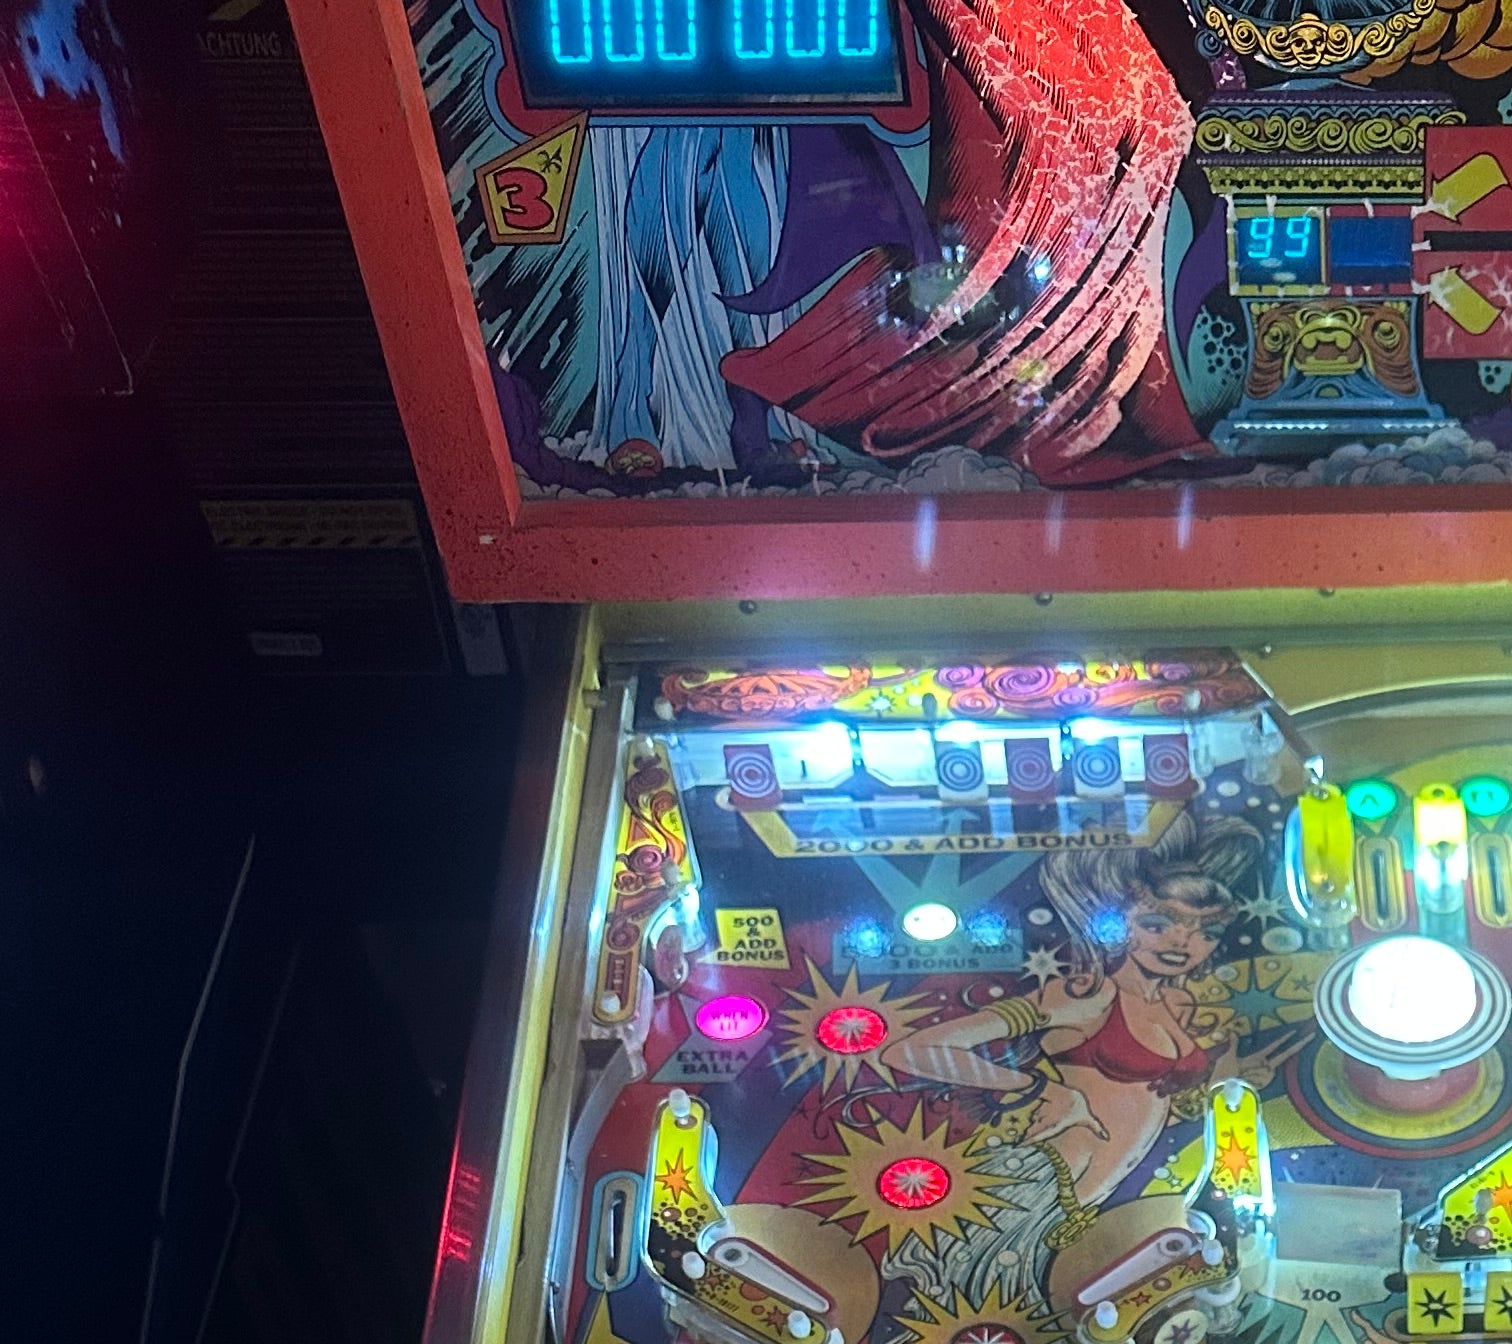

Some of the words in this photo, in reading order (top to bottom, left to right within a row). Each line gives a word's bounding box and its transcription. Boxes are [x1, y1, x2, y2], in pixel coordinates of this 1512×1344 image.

[493, 168, 553, 231] 3
[1247, 215, 1311, 259] 99
[795, 834, 895, 854] 2000
[904, 837, 924, 851] &
[931, 833, 1004, 852] ADD
[1015, 831, 1134, 850] BONUS
[733, 916, 774, 928] 500
[747, 927, 761, 938] &
[735, 938, 776, 951] ADD
[717, 949, 785, 962] BONUS
[677, 1050, 748, 1062] EXTRA
[682, 1062, 736, 1075] BALL
[1301, 1288, 1341, 1302] 100
